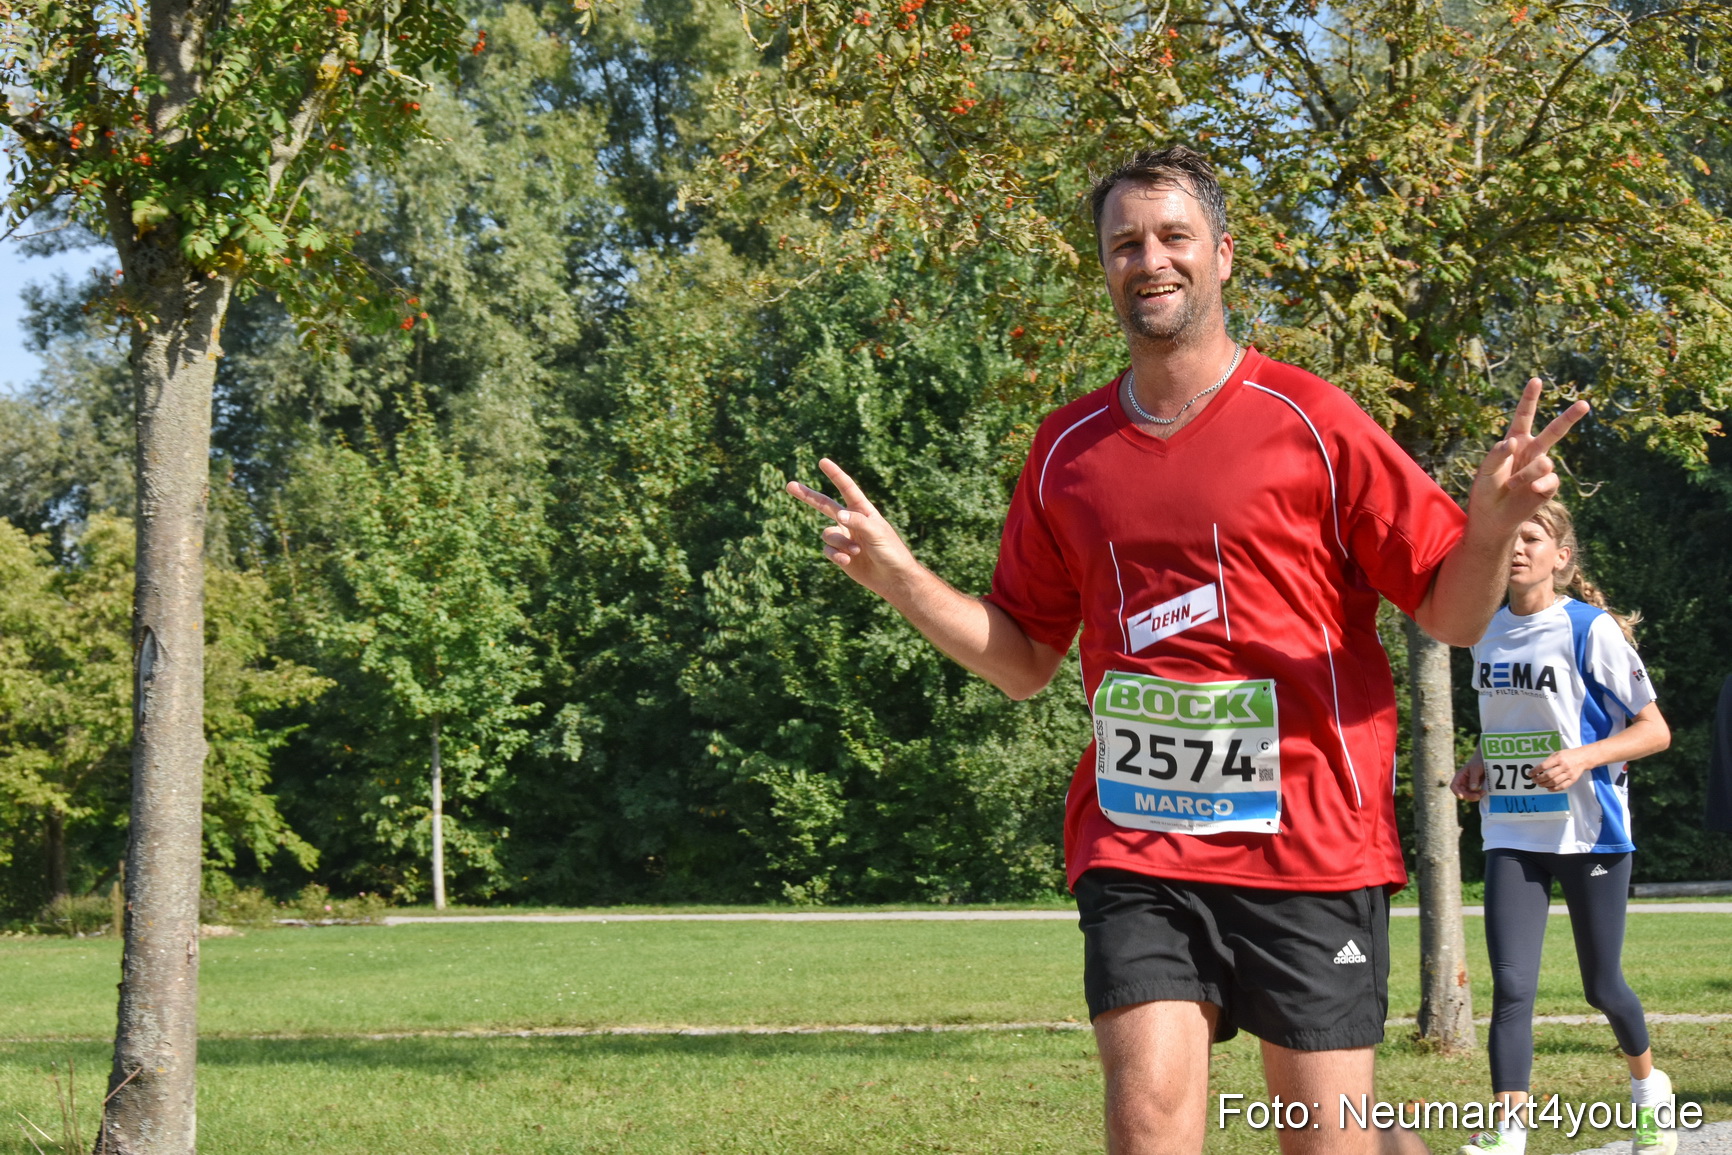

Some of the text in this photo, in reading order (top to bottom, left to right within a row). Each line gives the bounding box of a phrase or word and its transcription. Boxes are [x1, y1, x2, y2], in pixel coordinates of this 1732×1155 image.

[1151, 603, 1191, 632] DEHN
[1107, 679, 1260, 725] BOCK
[1115, 728, 1256, 784] 2574
[1260, 741, 1270, 751] C
[1486, 734, 1555, 756] BOCK
[1492, 763, 1543, 790] 279
[1134, 792, 1234, 817] MARCO
[1333, 954, 1367, 965] adidas
